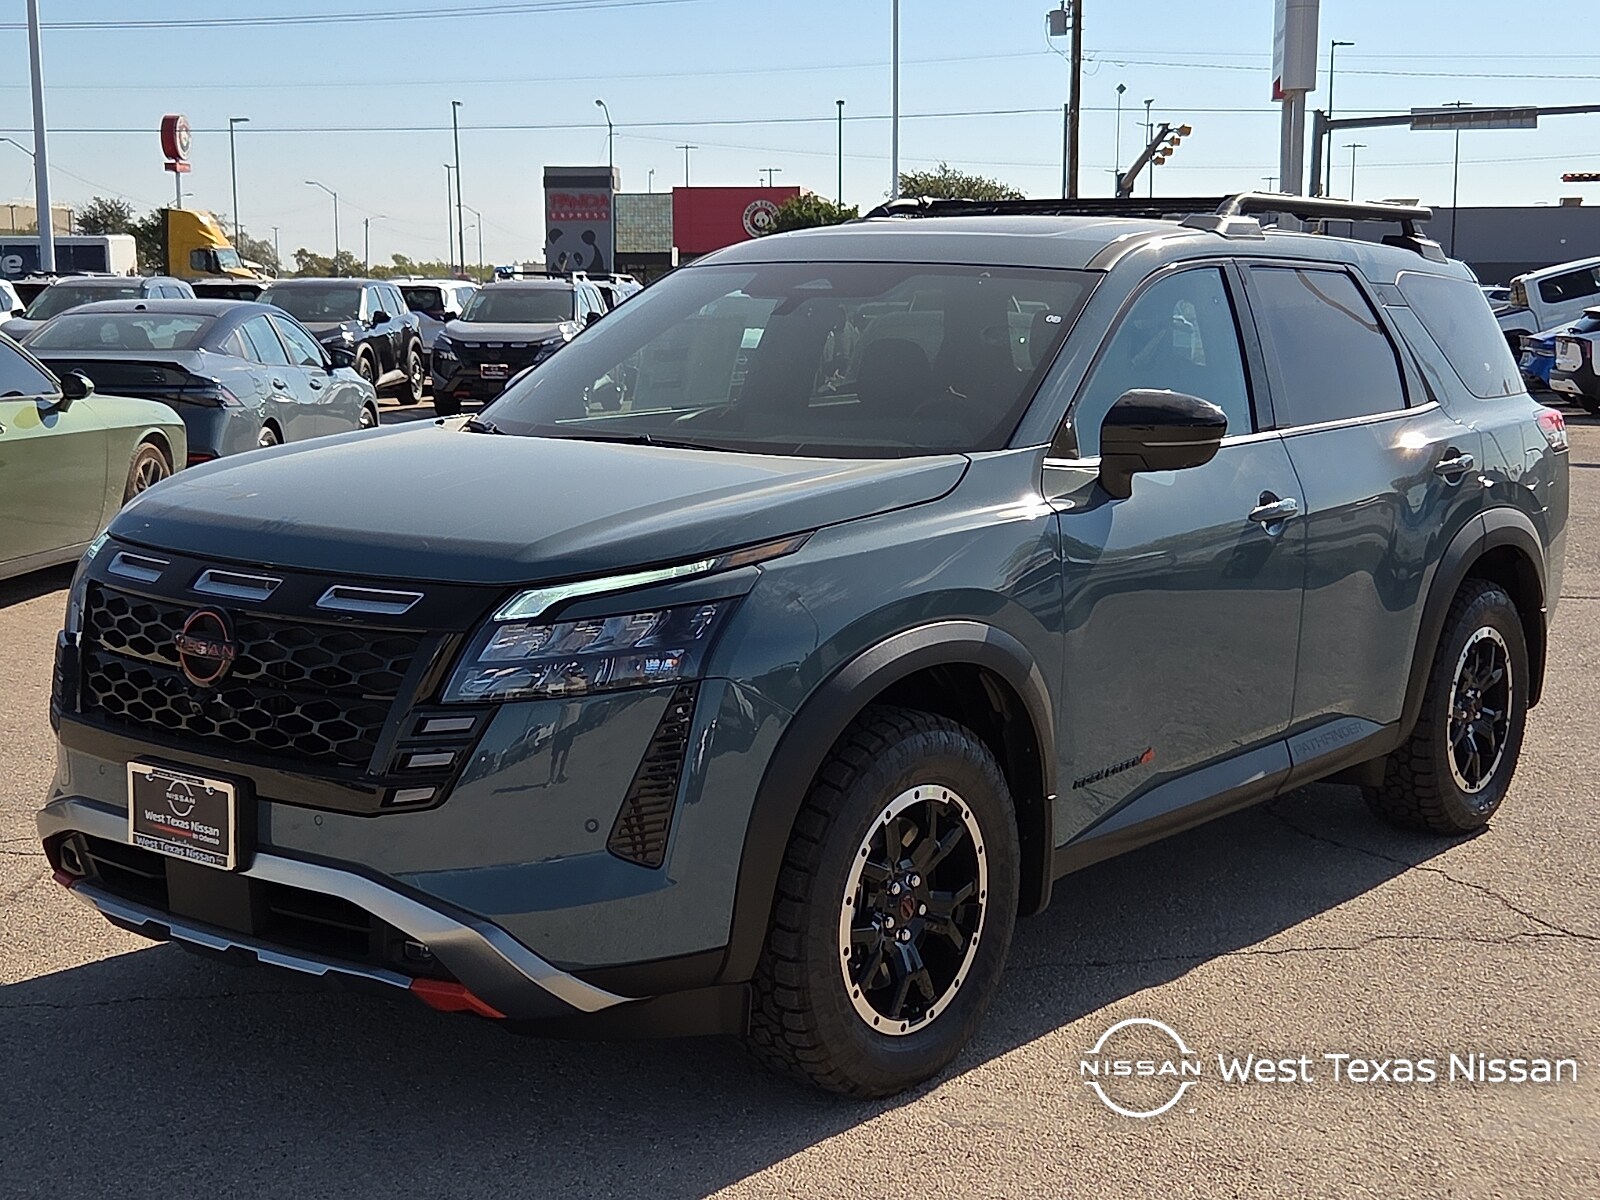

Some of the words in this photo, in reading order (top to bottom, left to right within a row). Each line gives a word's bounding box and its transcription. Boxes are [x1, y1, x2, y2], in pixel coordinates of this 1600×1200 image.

[1293, 722, 1364, 757] PATHFINDER
[166, 791, 196, 805] NISSAN
[144, 809, 166, 824] West
[166, 815, 190, 831] Texas
[190, 821, 220, 837] Nissan
[136, 836, 159, 850] West
[160, 842, 185, 857] Texas
[185, 848, 216, 864] Nissan
